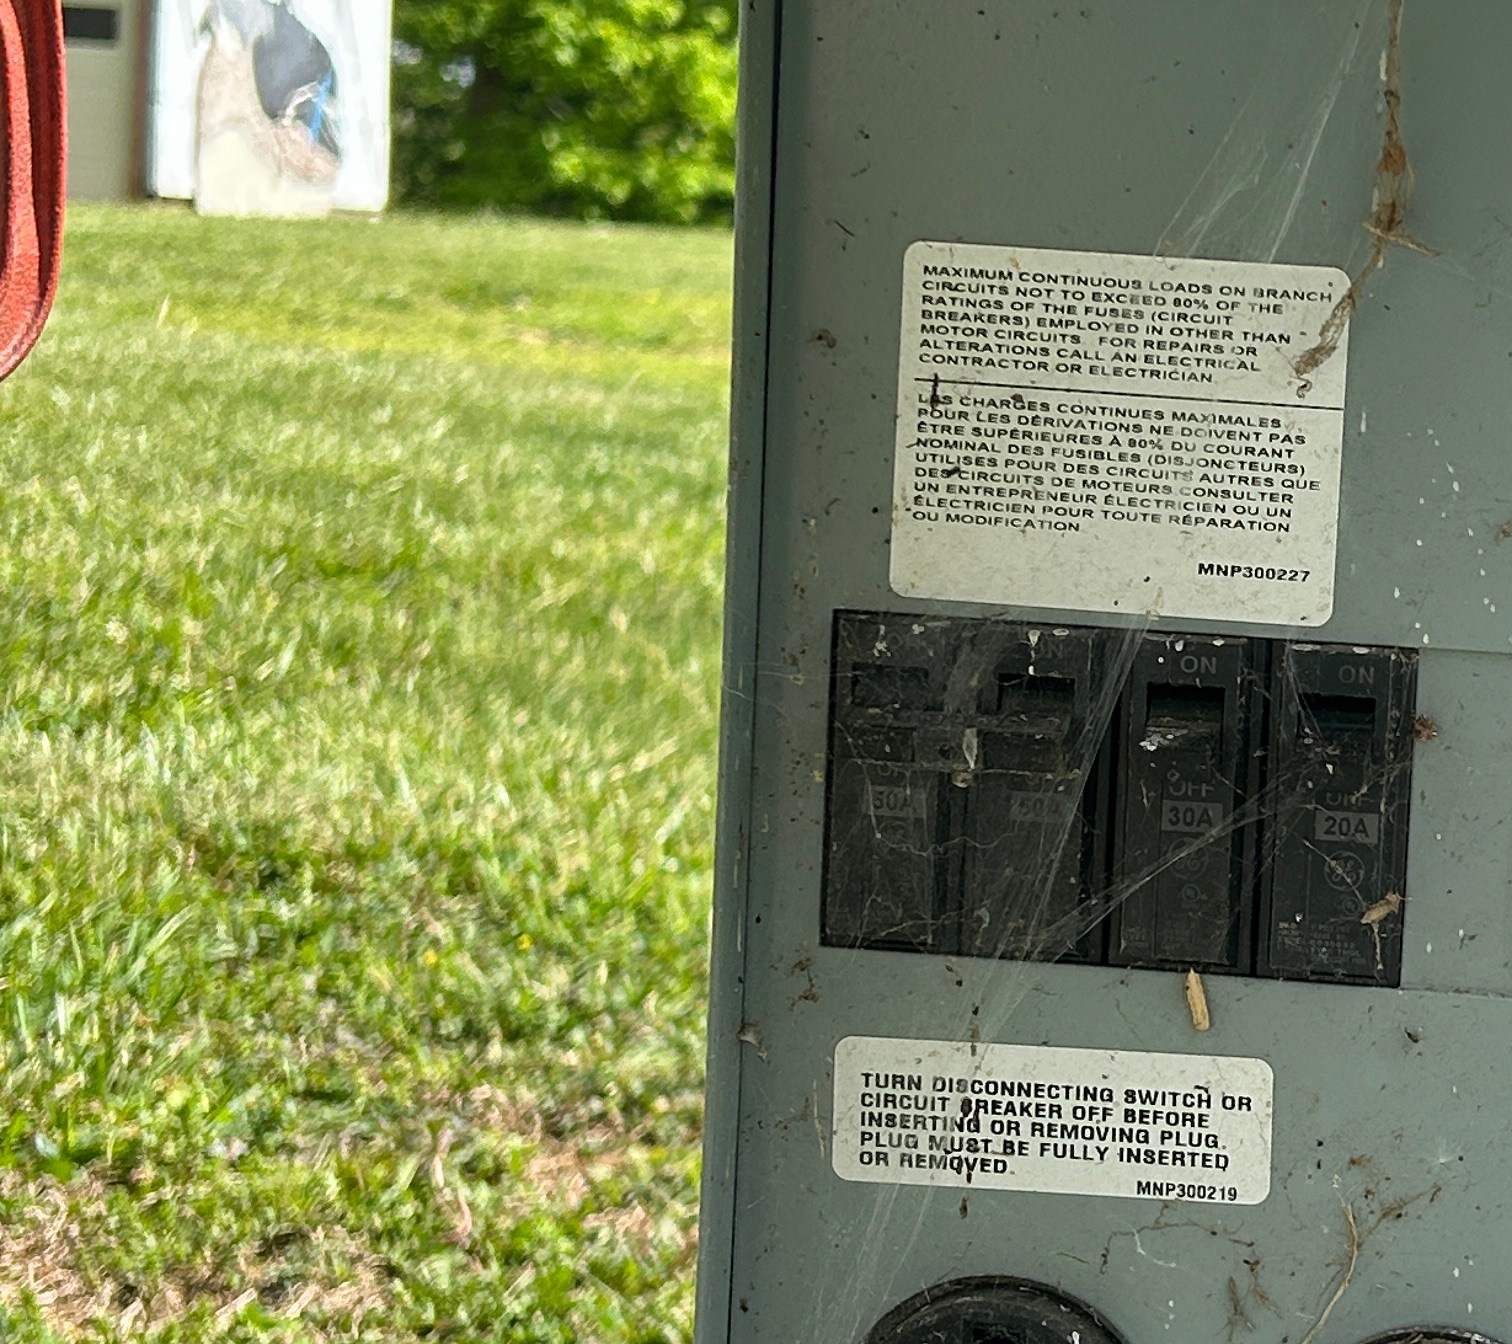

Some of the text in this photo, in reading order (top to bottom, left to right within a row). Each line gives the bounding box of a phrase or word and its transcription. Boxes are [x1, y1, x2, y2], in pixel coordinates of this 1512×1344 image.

[921, 279, 1283, 314] CIRCUITS NOT TO EXCEED 80% OF THE
[922, 264, 1332, 303] MAXIMUM CONTINUOUS LOADS ON BRANCH
[920, 308, 1291, 344] BREAKERS) EMPLOYED IN OTHER THAN
[921, 294, 1233, 326] RATINGS OF THE FUSES (CIRCUIT
[919, 337, 1261, 371] ALTERATIONS CALL AN ELECTRICAL
[920, 323, 988, 338] MOTOR
[1098, 335, 1136, 348] FOR
[1143, 338, 1224, 354] REPAIRS
[1231, 343, 1257, 356] OR
[918, 352, 1049, 372] CONTRACTOR
[1055, 361, 1082, 374] OR
[917, 393, 1282, 428] LS CHARGES CONTINUES MAXIMALES
[917, 407, 1306, 445] POUR LES DÉRIVATIONS NE DOIVENT PAS
[915, 437, 1001, 454] NOMINAL
[1007, 443, 1044, 457] DES
[1050, 446, 1141, 463] FUSIBLES
[1127, 435, 1163, 450] 80%
[1170, 438, 1196, 452] DU
[1202, 440, 1295, 459] COURANT
[914, 451, 1321, 490] UTILISES POUR DES CIRCUITS AUTRES QUE
[914, 466, 951, 480] DES
[957, 469, 1044, 487] CIRCUITS
[1051, 475, 1075, 489] DE
[1179, 484, 1294, 503] CONSULTER
[913, 480, 939, 494] UN
[945, 482, 1097, 505] ENTREPRENEUR
[1232, 502, 1260, 516] OU
[1266, 504, 1292, 518] UN
[912, 510, 1080, 532] OU MODIFICATION
[1042, 503, 1094, 519] POUR
[1100, 506, 1162, 523] TOUTE
[1168, 511, 1290, 532] RÉPARATION
[1197, 562, 1311, 582] MNP300227
[1180, 655, 1217, 674] ON
[1338, 665, 1374, 684] ON
[1168, 806, 1214, 827] 30A
[1323, 815, 1369, 837] 20A
[861, 1072, 1252, 1110] TURN DISCONNECTING SWITCH OR
[860, 1092, 1209, 1128] CIRCUIT REAKER OFF BEFORE
[860, 1111, 1227, 1148] INSERTING OR REMOVING PLUG.
[858, 1150, 888, 1167] OR
[860, 1131, 1229, 1168] PLUG MUST BE FULLY INSERTED
[1136, 1180, 1238, 1201] MNP300219
